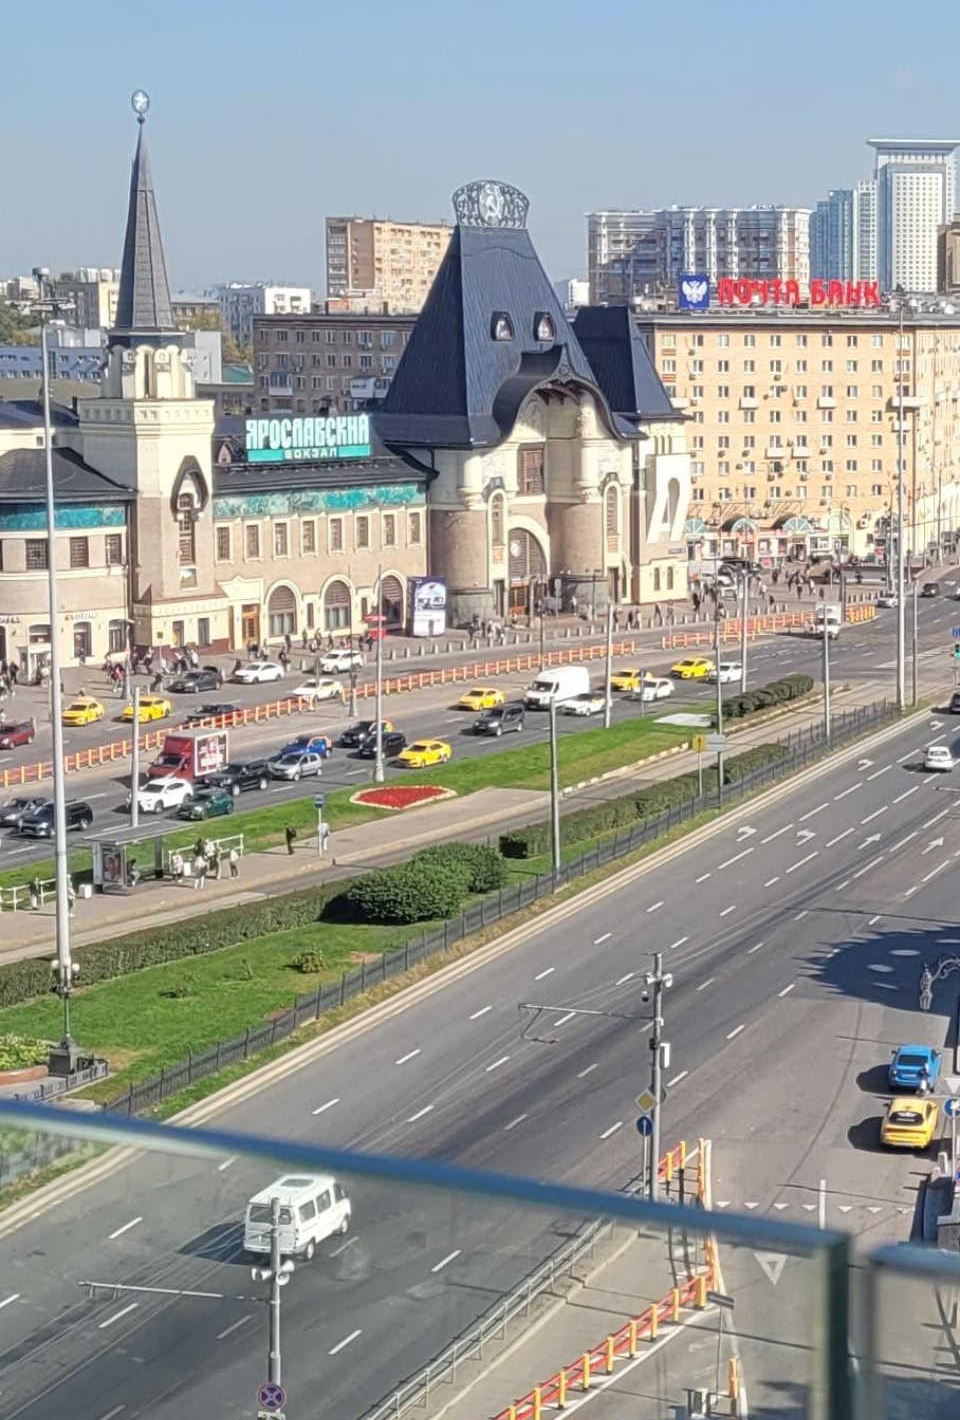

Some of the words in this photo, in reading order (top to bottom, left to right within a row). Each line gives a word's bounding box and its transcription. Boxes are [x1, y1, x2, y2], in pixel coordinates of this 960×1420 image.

[718, 277, 800, 305] ПОЧТА
[810, 279, 880, 306] БАНК
[245, 413, 370, 450] ЯРОСЛАВСКИЙ
[284, 447, 337, 459] ВОКЗАЛ
